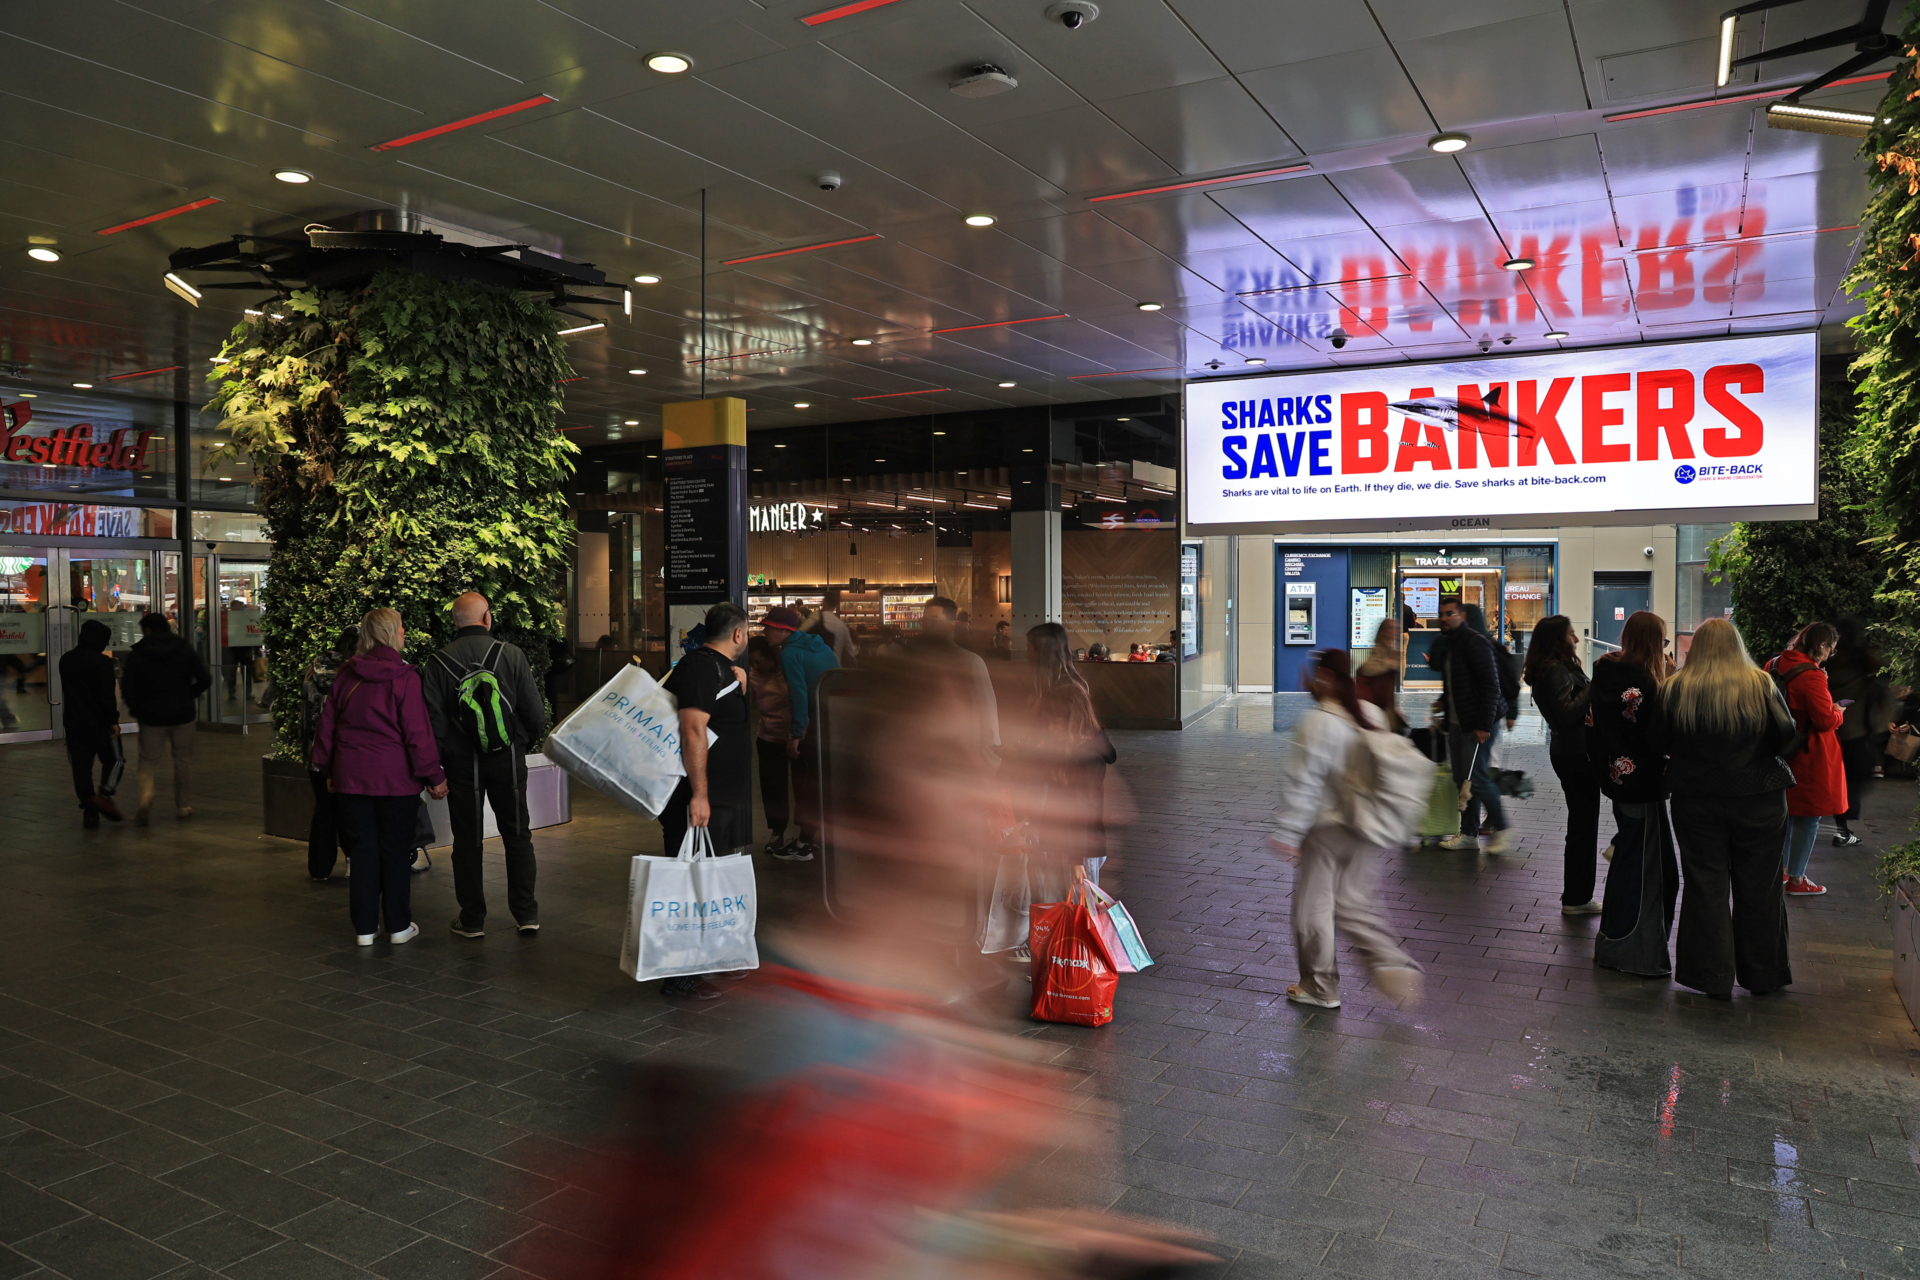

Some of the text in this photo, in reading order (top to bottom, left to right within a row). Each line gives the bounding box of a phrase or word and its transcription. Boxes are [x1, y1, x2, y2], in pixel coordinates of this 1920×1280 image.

[1222, 394, 1332, 430] SHARKS
[1340, 363, 1764, 475] BANKERS
[1222, 430, 1332, 480] SAVE
[1699, 464, 1764, 476] BITE-BACK
[1222, 488, 1252, 498] Sharks
[1254, 488, 1269, 497] are
[1270, 486, 1290, 496] vital
[1292, 486, 1302, 495] to
[1304, 484, 1317, 494] life
[1334, 483, 1362, 493] Earth.
[1364, 483, 1372, 492] If
[1373, 482, 1394, 494] they
[1397, 482, 1414, 492] die,
[1417, 482, 1432, 490] we
[1434, 480, 1452, 490] die.
[1454, 479, 1479, 489] Save
[1482, 476, 1516, 488] sharks
[1518, 478, 1529, 486] at
[1531, 474, 1606, 486] bite-back.com
[750, 502, 806, 532] MANGER
[1452, 518, 1490, 527] OCEAN
[1415, 557, 1488, 565] TRAVEL CASHIER
[605, 710, 666, 758] LOVE THE FEELING
[651, 895, 746, 918] PRIMARK
[668, 918, 736, 931] LOVE THE FEELING
